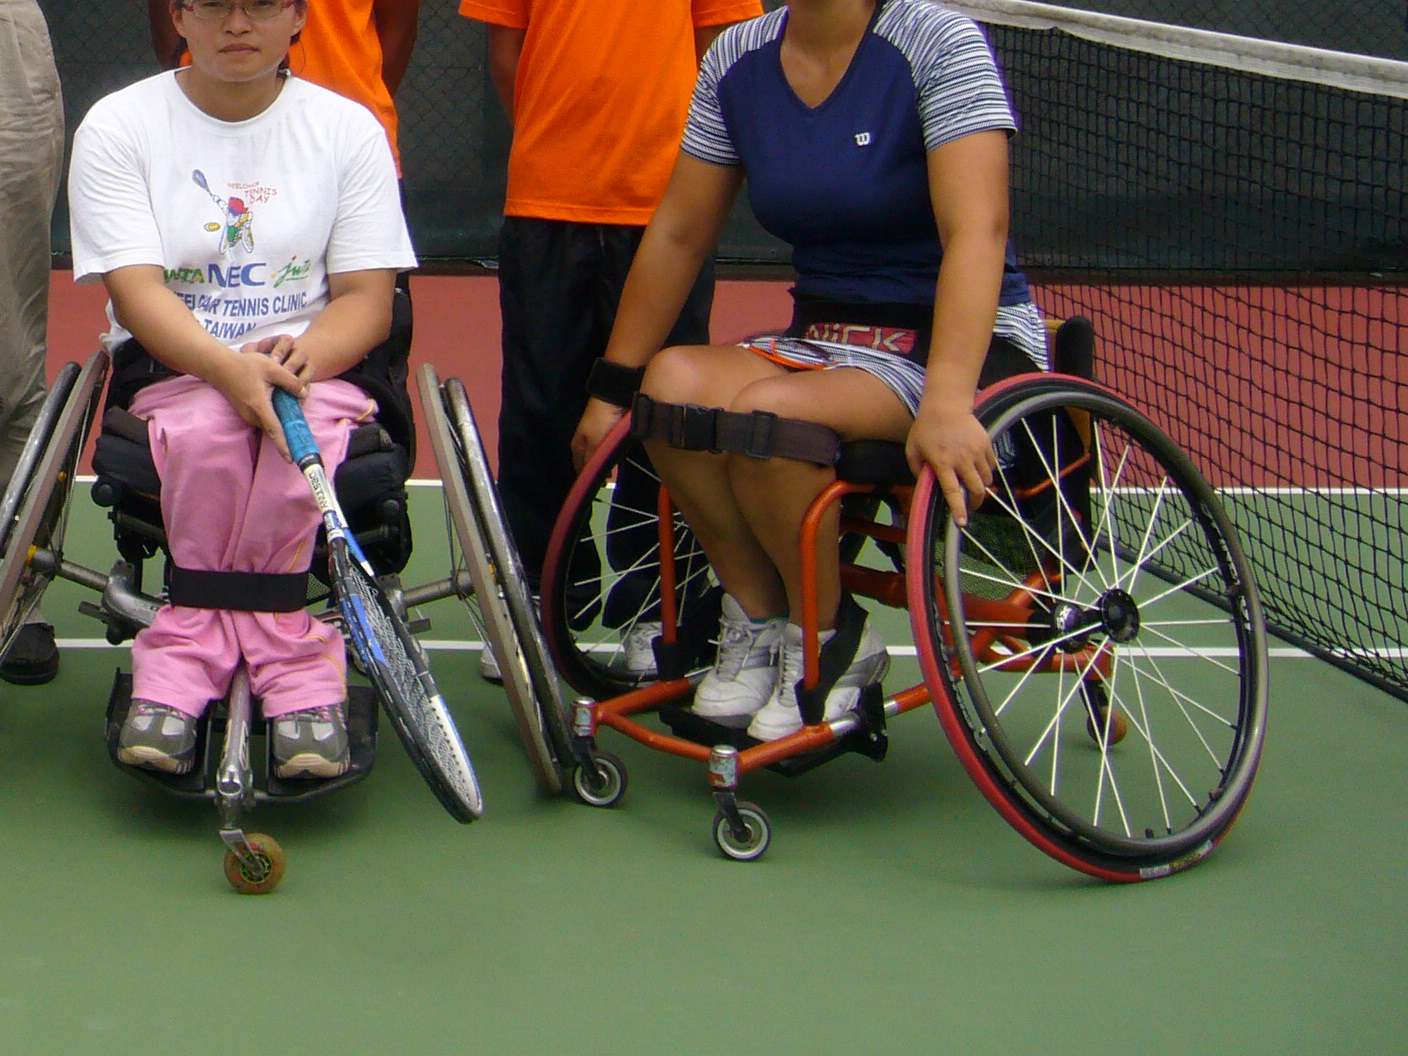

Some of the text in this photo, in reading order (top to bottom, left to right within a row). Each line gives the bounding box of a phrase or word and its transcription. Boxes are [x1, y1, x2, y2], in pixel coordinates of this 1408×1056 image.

[208, 262, 267, 288] NEC
[223, 297, 269, 317] TENNIS
[272, 291, 308, 314] CLINIC
